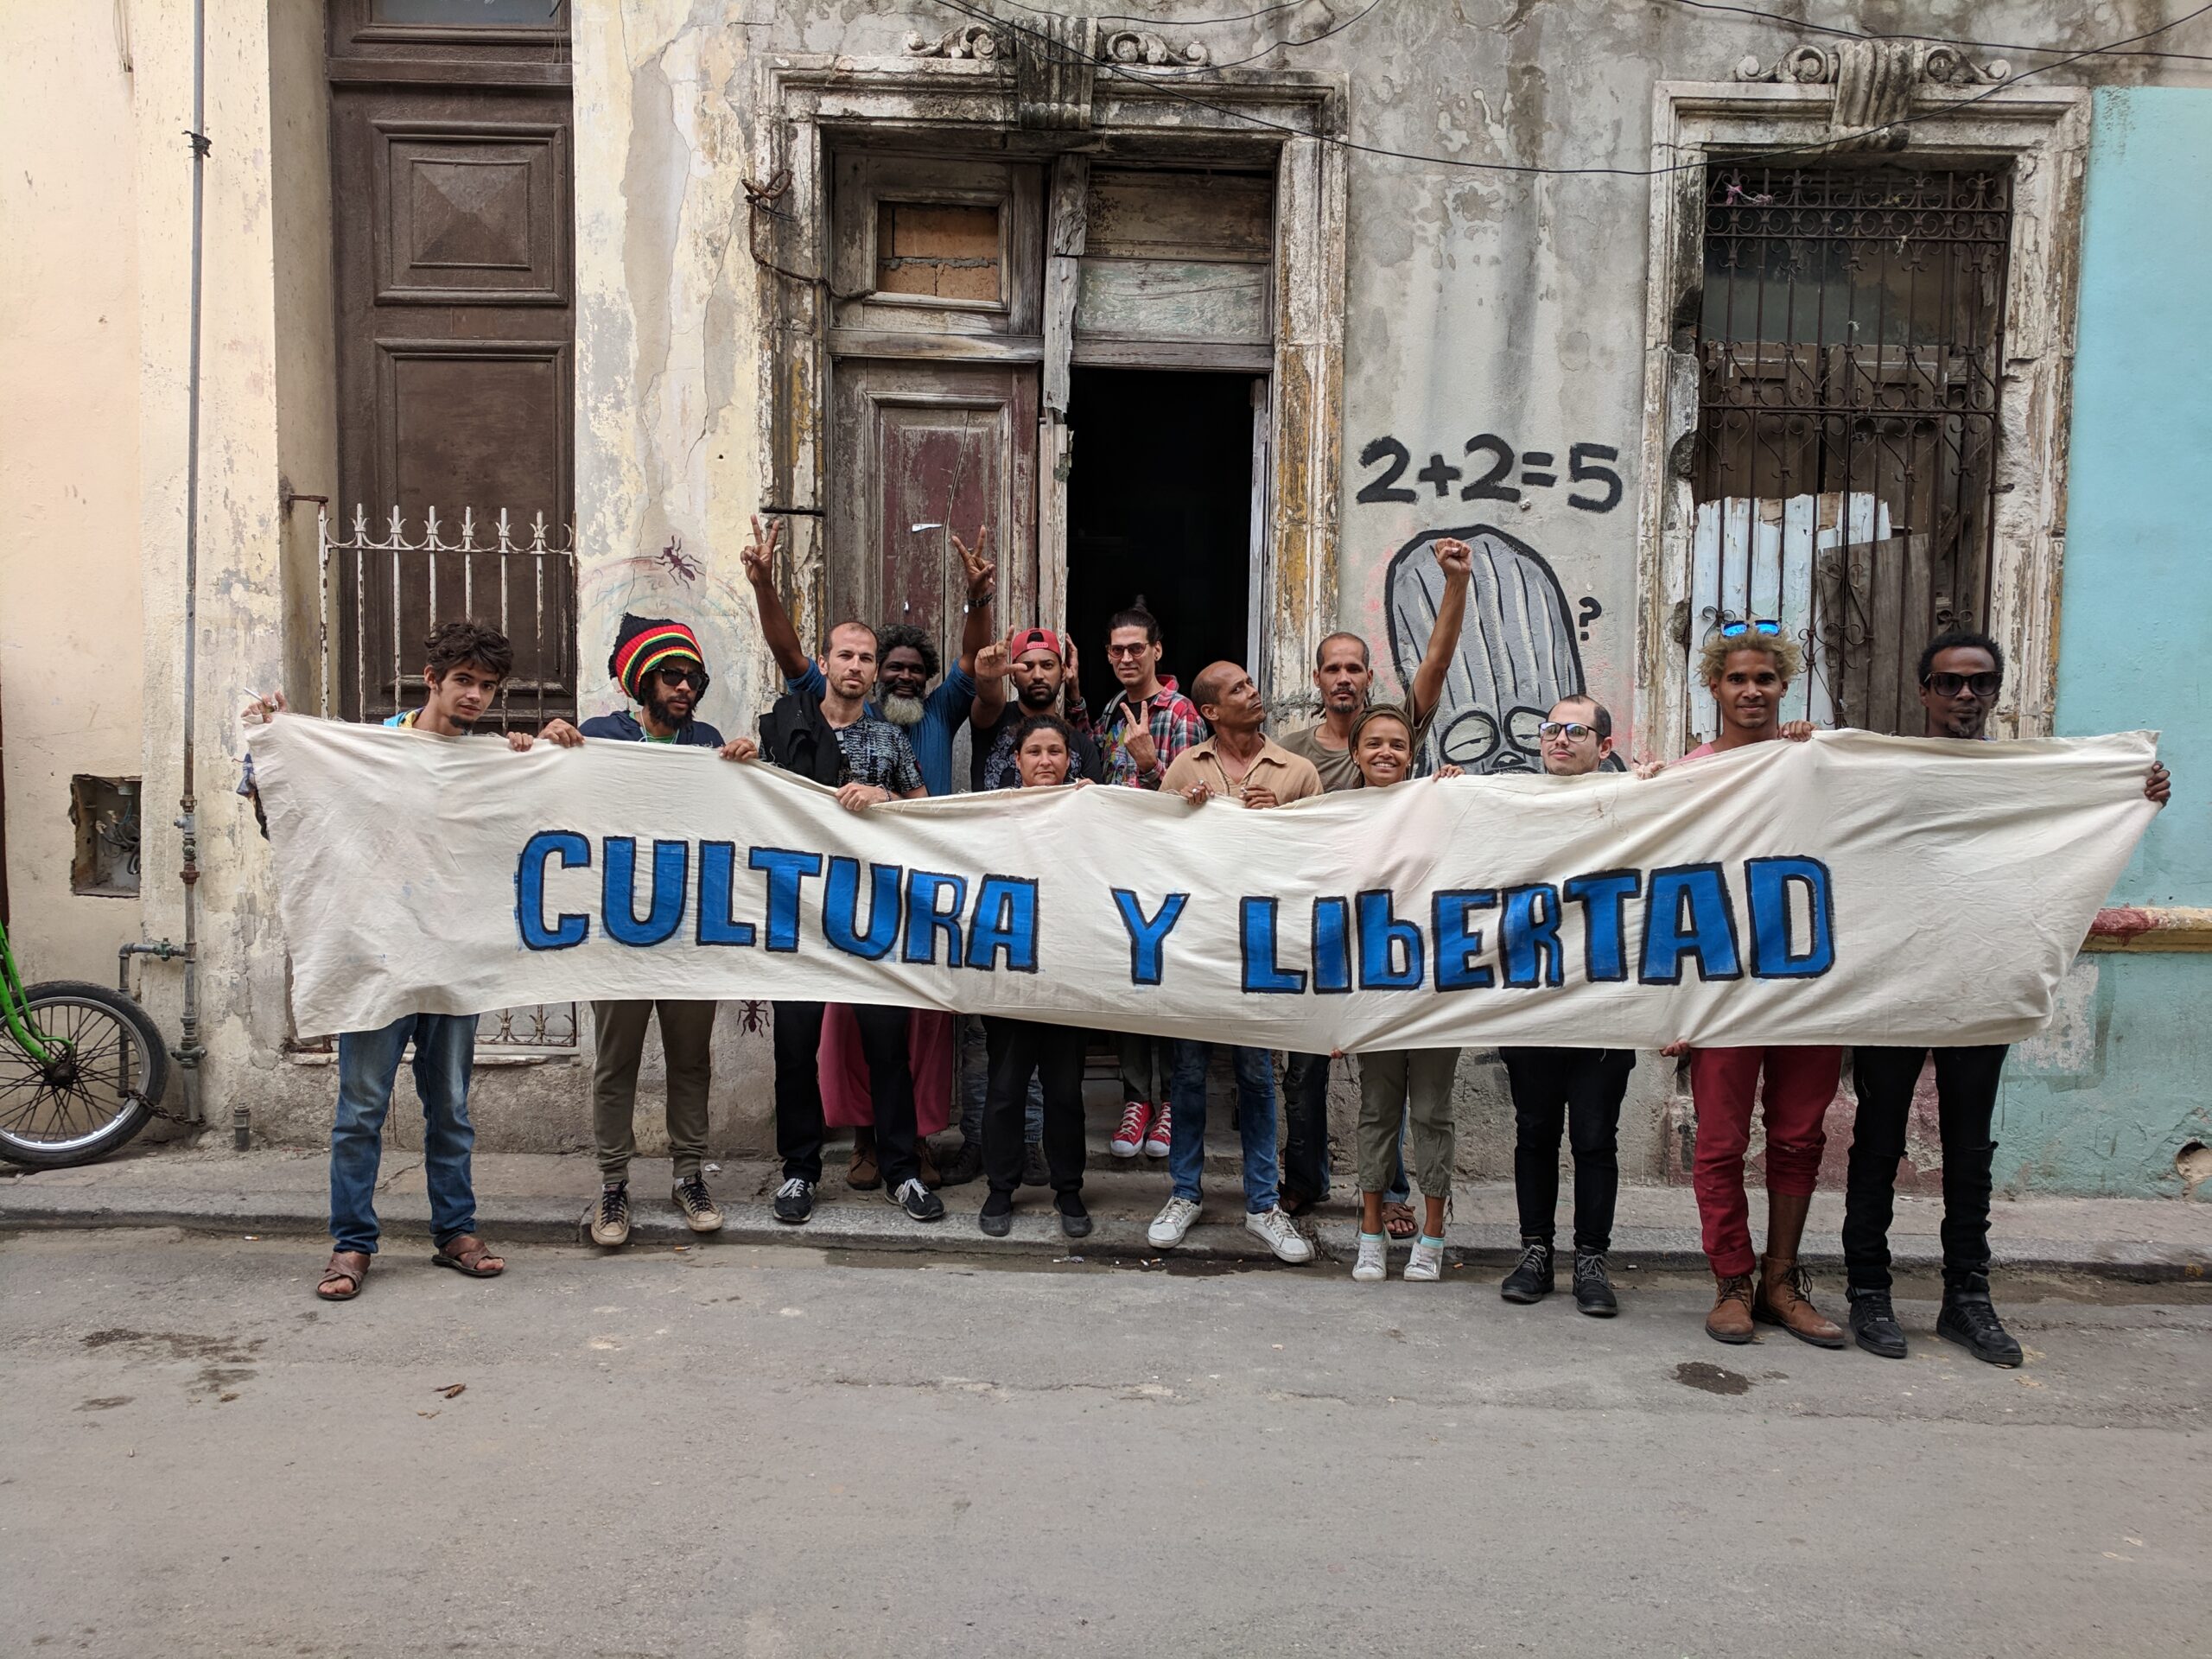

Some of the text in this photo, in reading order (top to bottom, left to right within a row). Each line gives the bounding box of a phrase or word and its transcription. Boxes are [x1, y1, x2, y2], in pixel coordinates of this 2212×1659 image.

[1356, 433, 1623, 513] 2+2=5
[1578, 596, 1602, 641] ?
[518, 829, 1039, 974] CULTURA
[1109, 887, 1191, 985] Y
